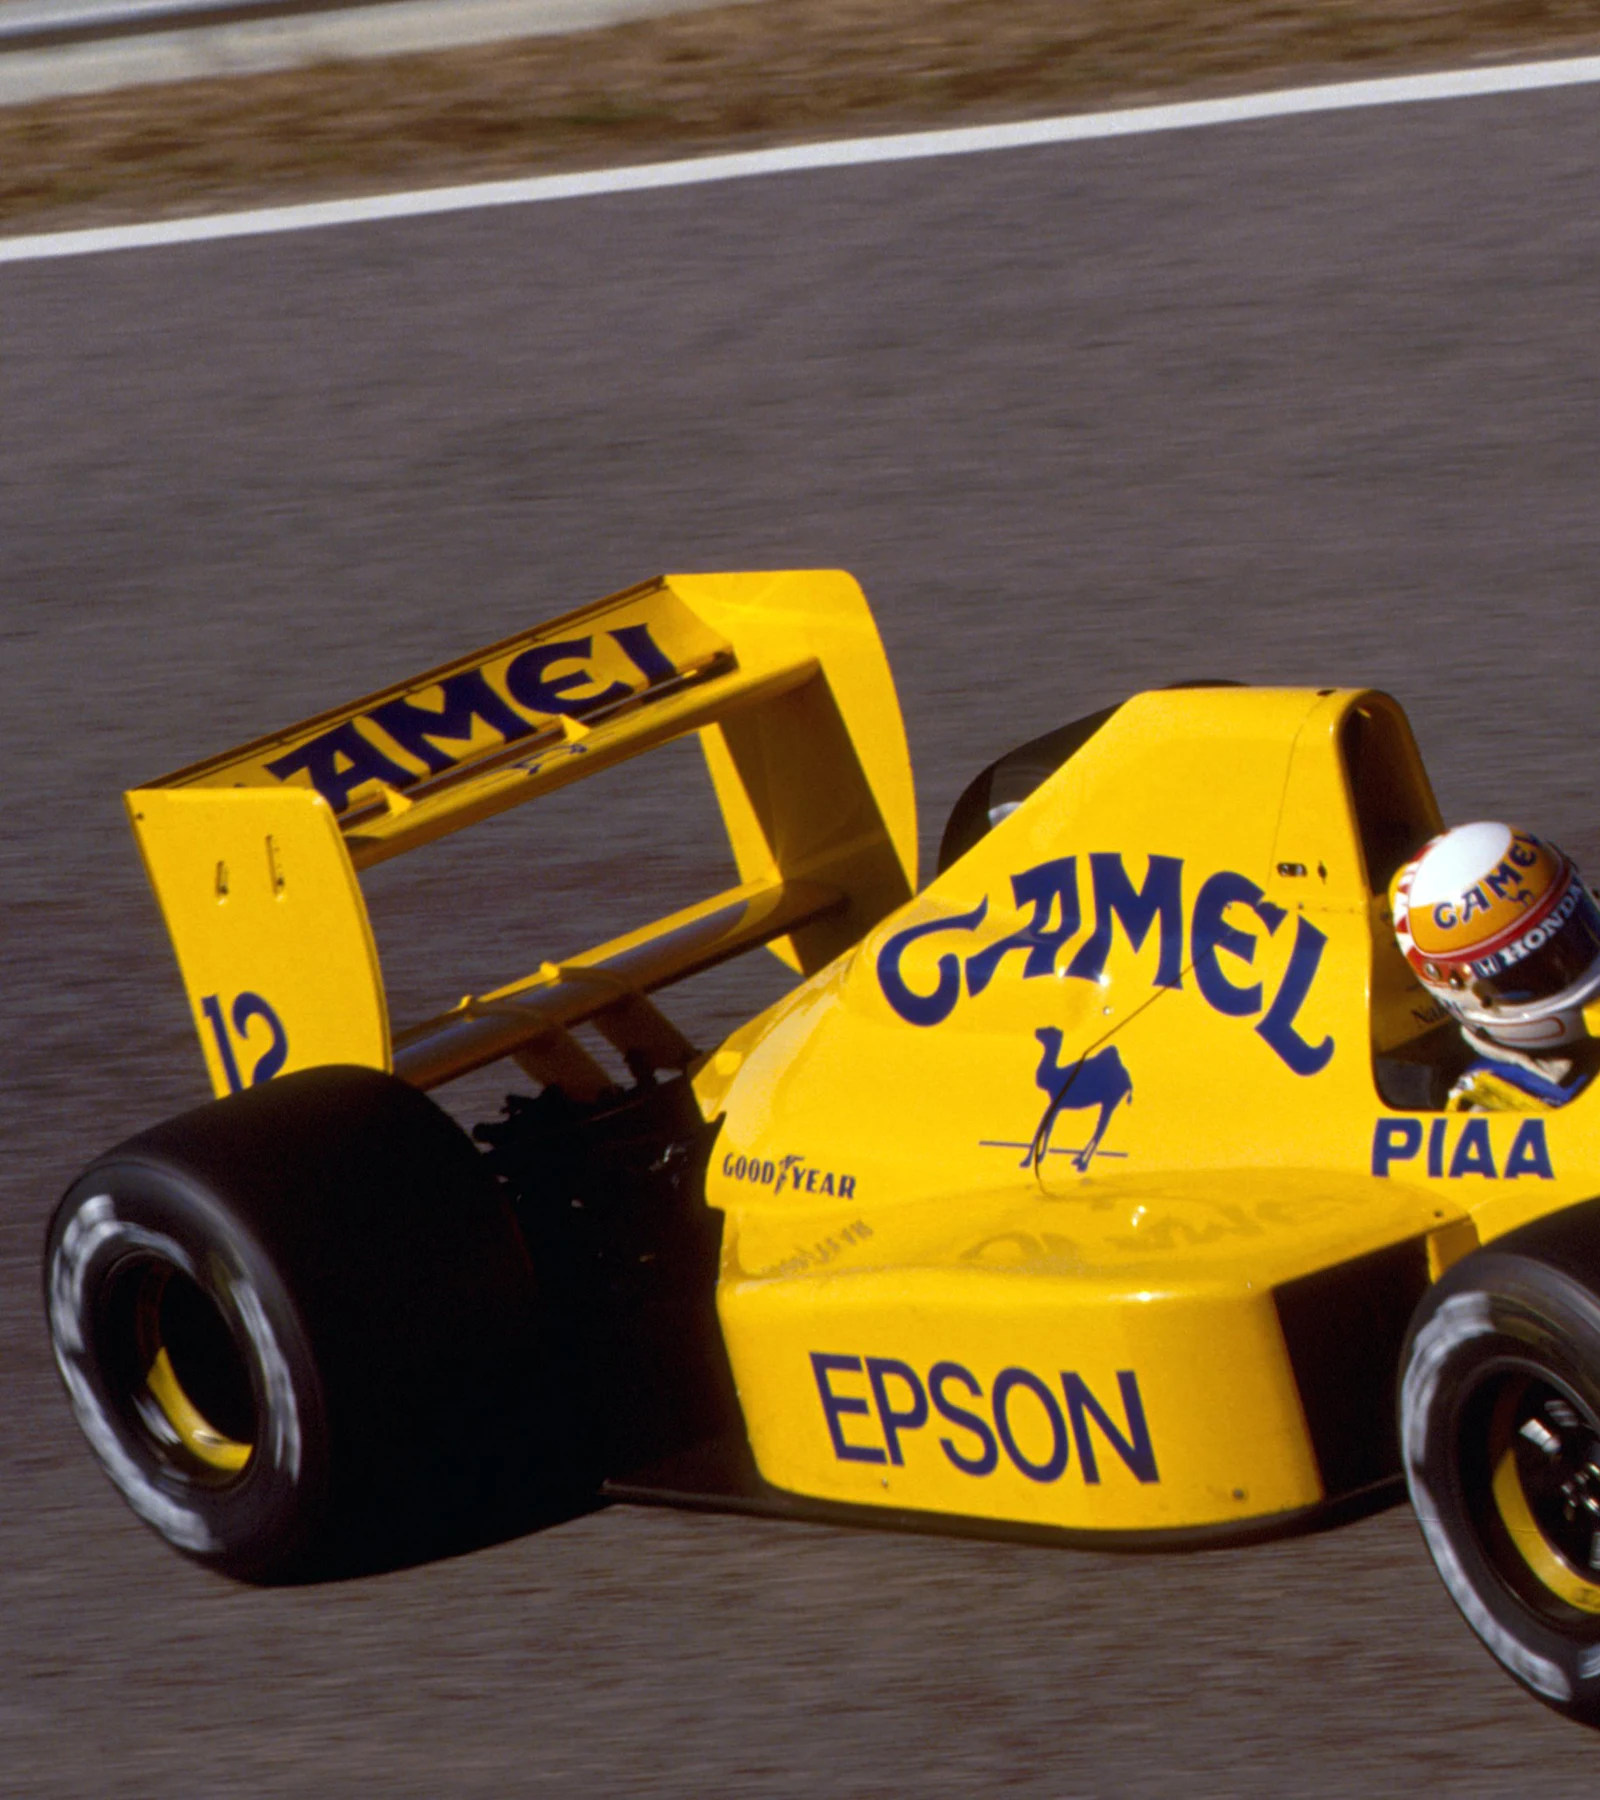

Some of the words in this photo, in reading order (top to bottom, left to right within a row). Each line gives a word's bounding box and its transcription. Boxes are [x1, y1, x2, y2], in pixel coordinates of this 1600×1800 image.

[876, 852, 1335, 1077] CAMEL
[201, 990, 289, 1094] 12
[1371, 1117, 1556, 1180] PIAA
[810, 1352, 1160, 1485] EPSON
